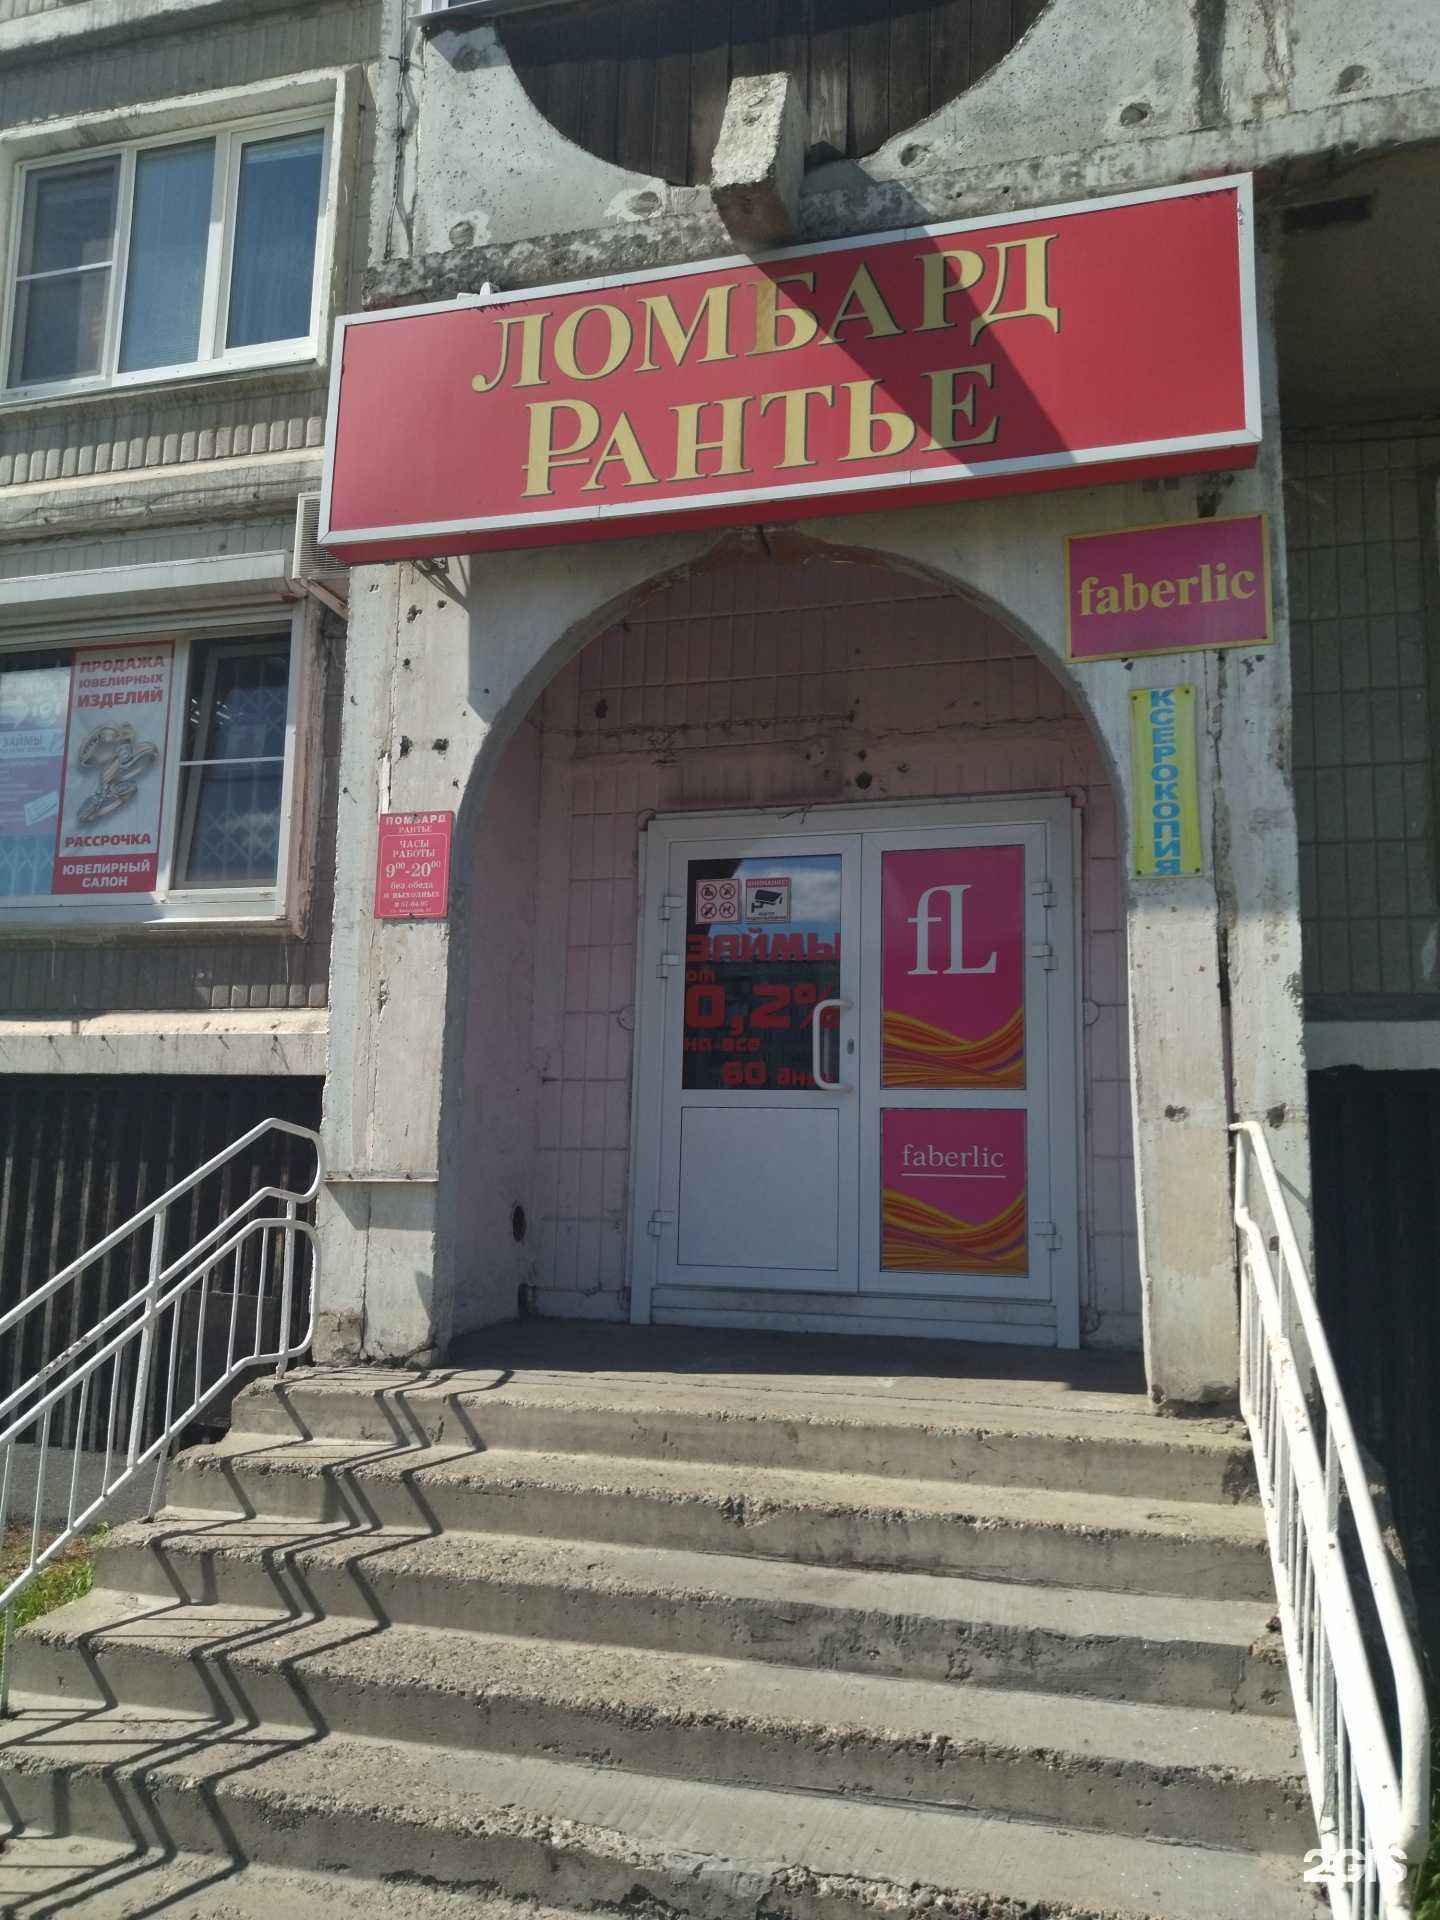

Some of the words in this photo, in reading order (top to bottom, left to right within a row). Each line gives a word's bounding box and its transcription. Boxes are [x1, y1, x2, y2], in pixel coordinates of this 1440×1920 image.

[472, 234, 1060, 394] ЛОМБАРД
[522, 363, 998, 499] РАНТЬЕ
[1078, 562, 1256, 616] faberlic
[79, 656, 165, 673] ПРОДАЖА
[79, 673, 163, 689] ЮВЕЛИРНЫХ
[77, 686, 163, 709] ИЗДЕЛИЙ
[1150, 688, 1181, 876] КСЕРОКОПИЯ
[386, 815, 447, 825] ЛОМБАРД
[399, 824, 433, 833] РАНТЬЕ
[65, 833, 151, 848] РАССРОЧКА
[400, 840, 429, 848] ЧАСЫ
[393, 848, 435, 858] РАБОТЫ
[62, 860, 150, 875] ЮВЕЛИРНЫЙ
[82, 876, 128, 888] САЛОН
[722, 1060, 767, 1086] 60
[902, 1144, 1004, 1168] faberlic
